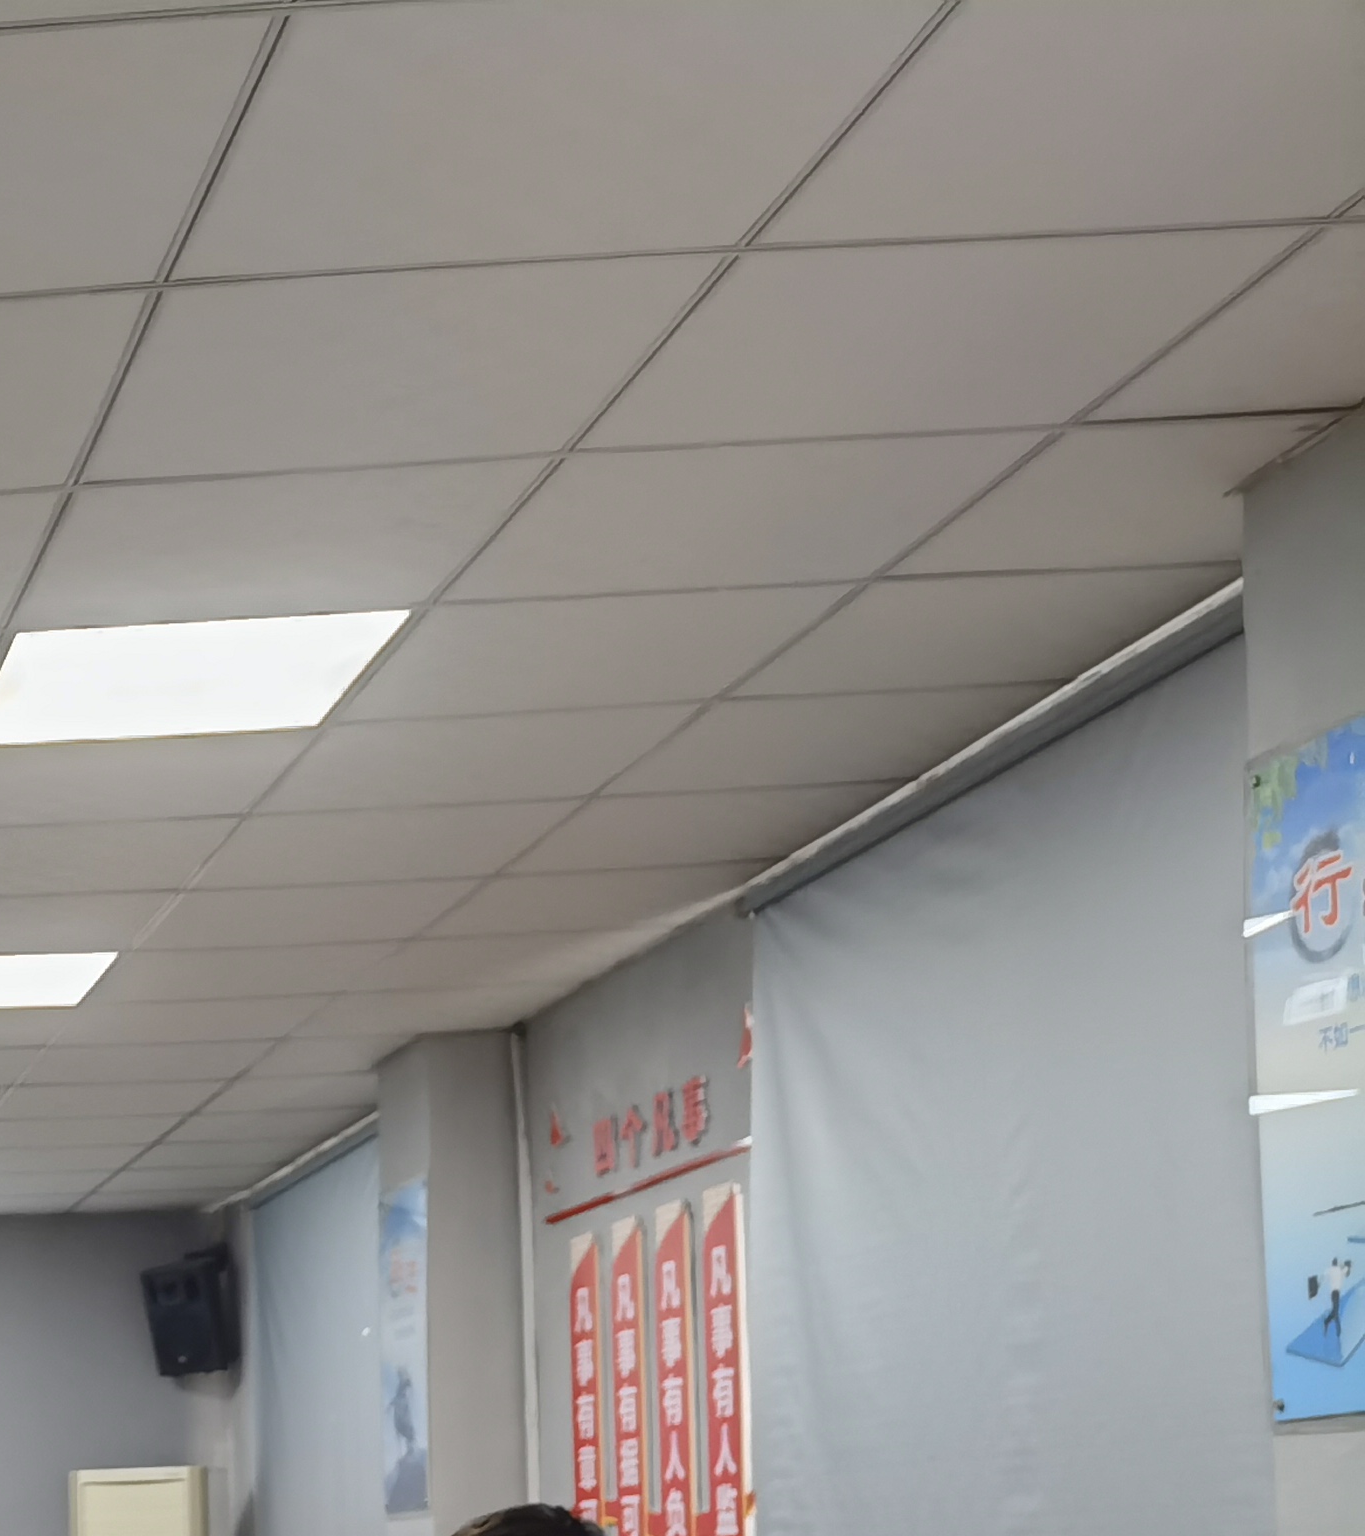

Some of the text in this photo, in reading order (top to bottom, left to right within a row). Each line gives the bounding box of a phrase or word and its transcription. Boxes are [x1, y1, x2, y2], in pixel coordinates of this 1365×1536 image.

[1291, 850, 1353, 934] 行
[592, 1074, 707, 1177] 四个凡事
